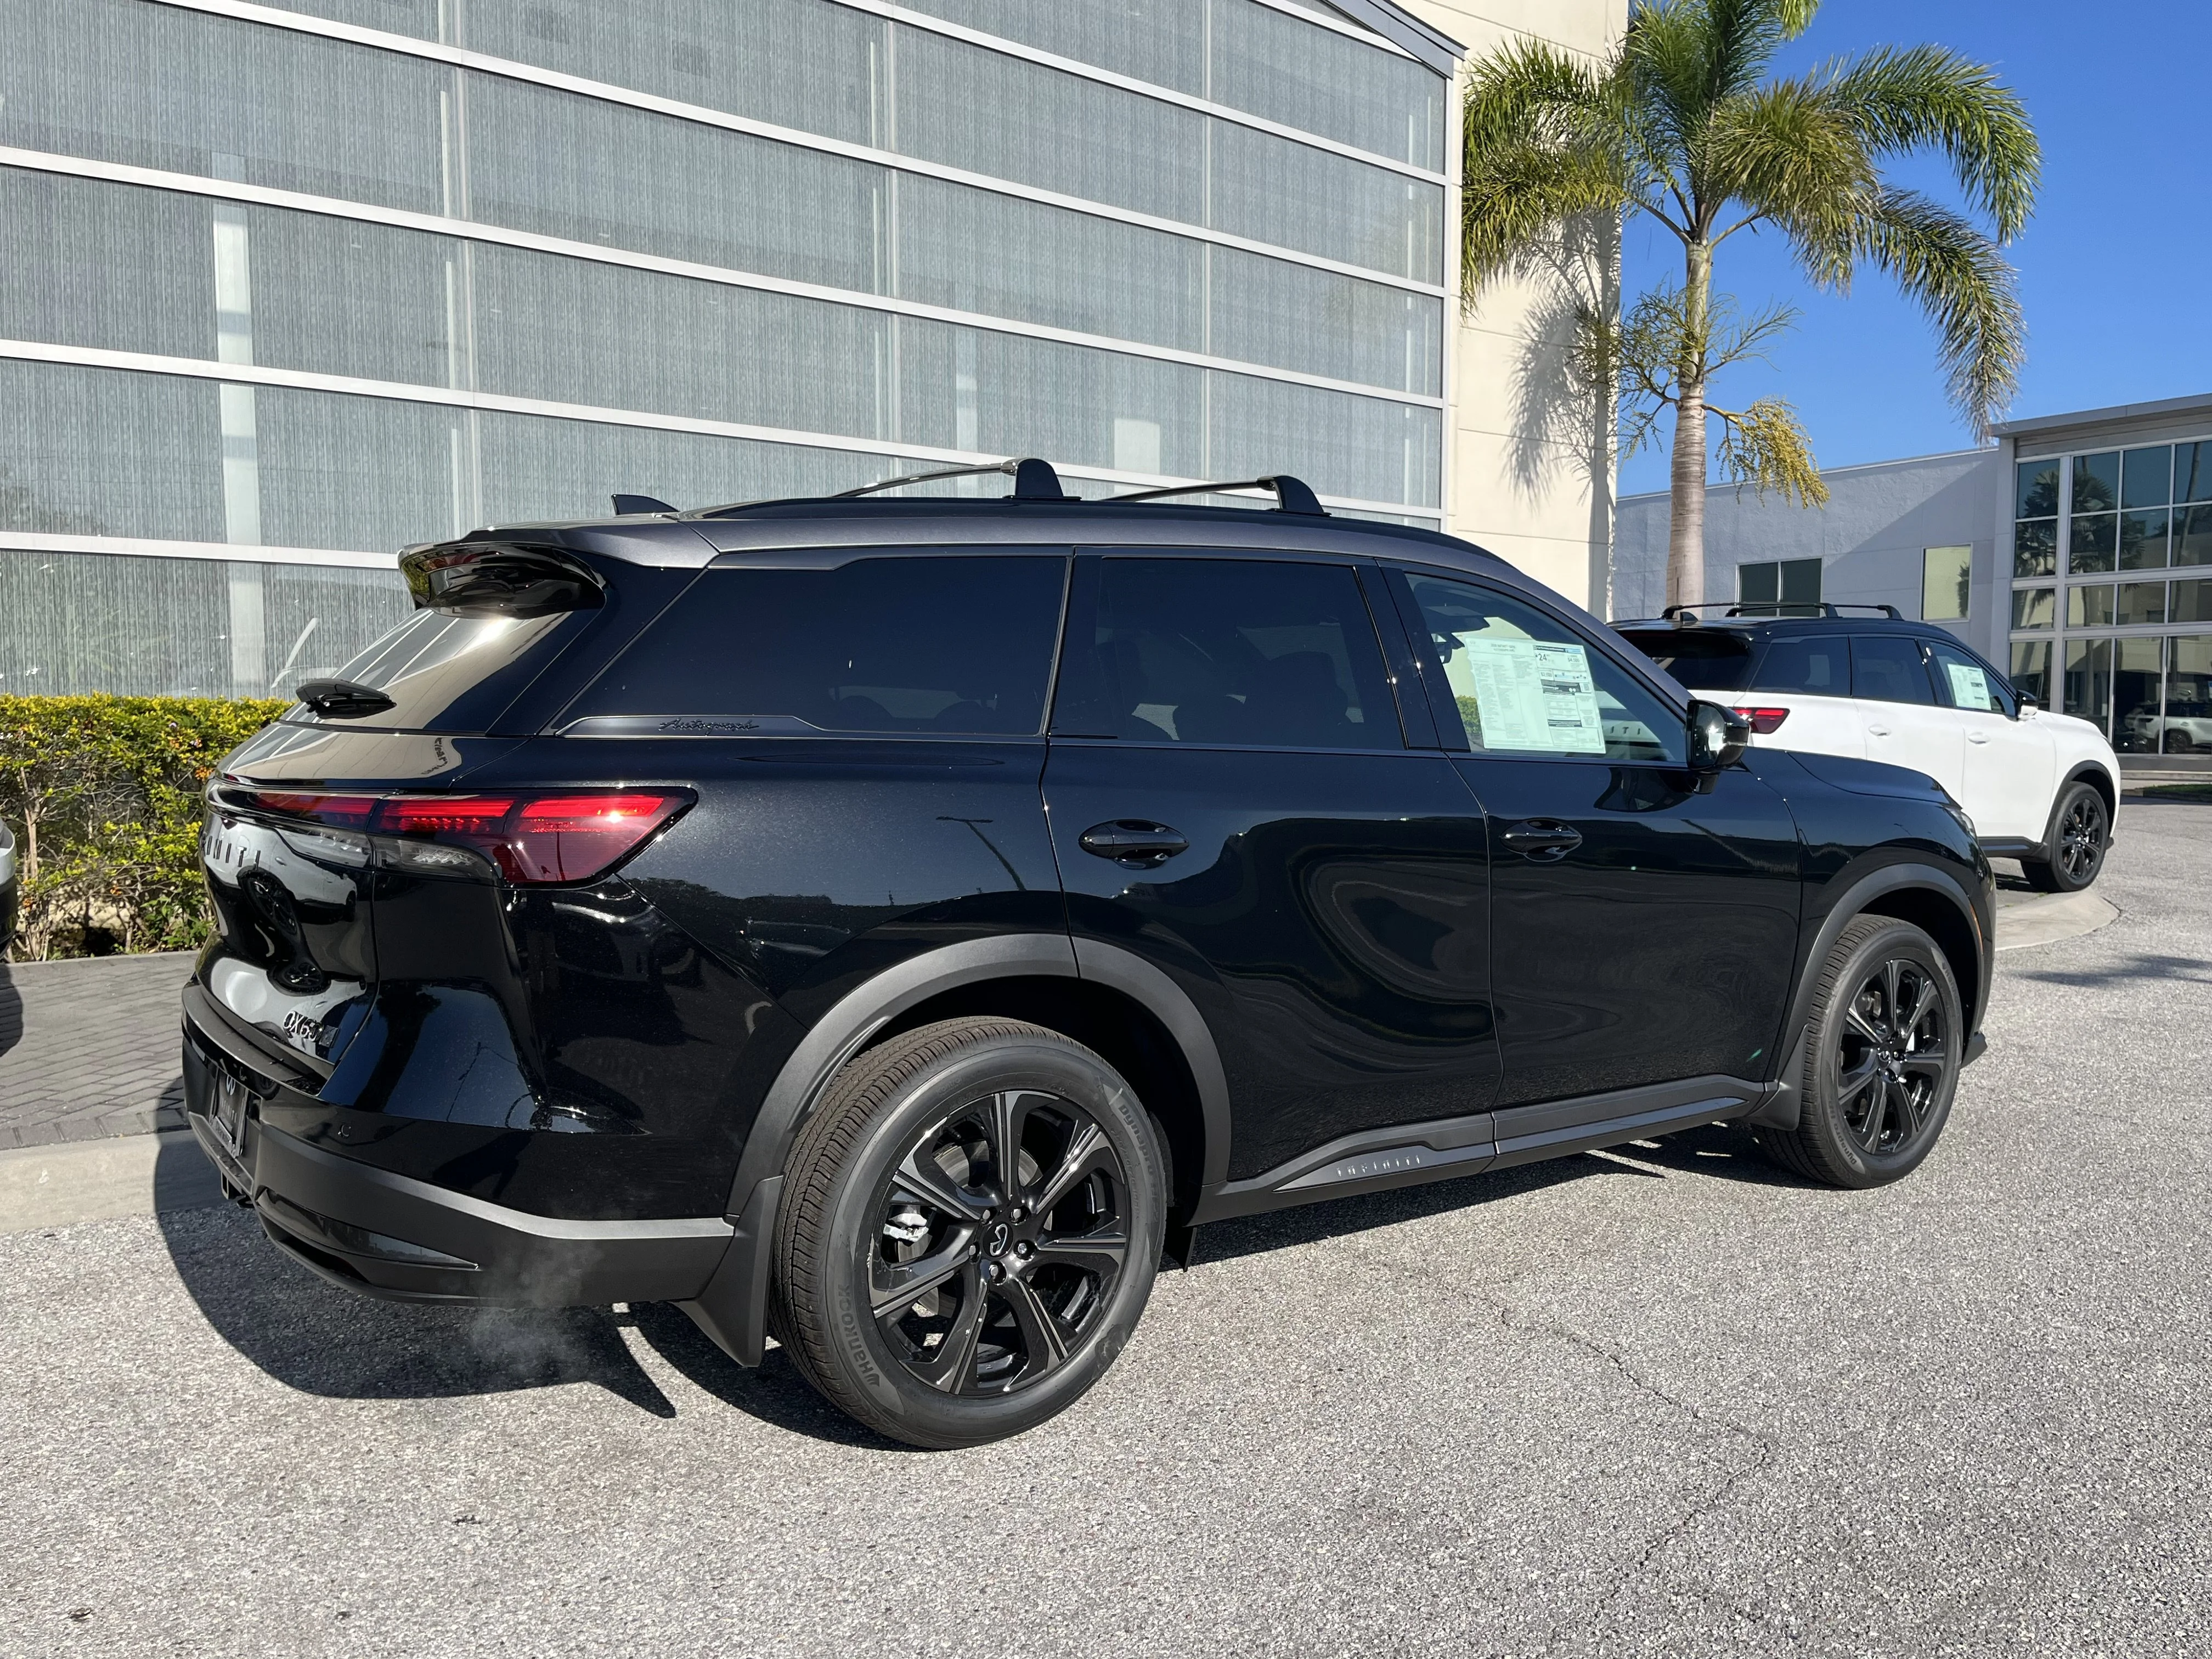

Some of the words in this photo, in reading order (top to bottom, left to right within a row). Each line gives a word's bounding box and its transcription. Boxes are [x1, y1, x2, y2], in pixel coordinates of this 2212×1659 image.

[1538, 653, 1547, 661] 24
[657, 717, 760, 737] Autograph
[1118, 1104, 1154, 1176] Dynapro
[1833, 1123, 1858, 1165] Dynapro
[1336, 1154, 1420, 1177] INFINITI
